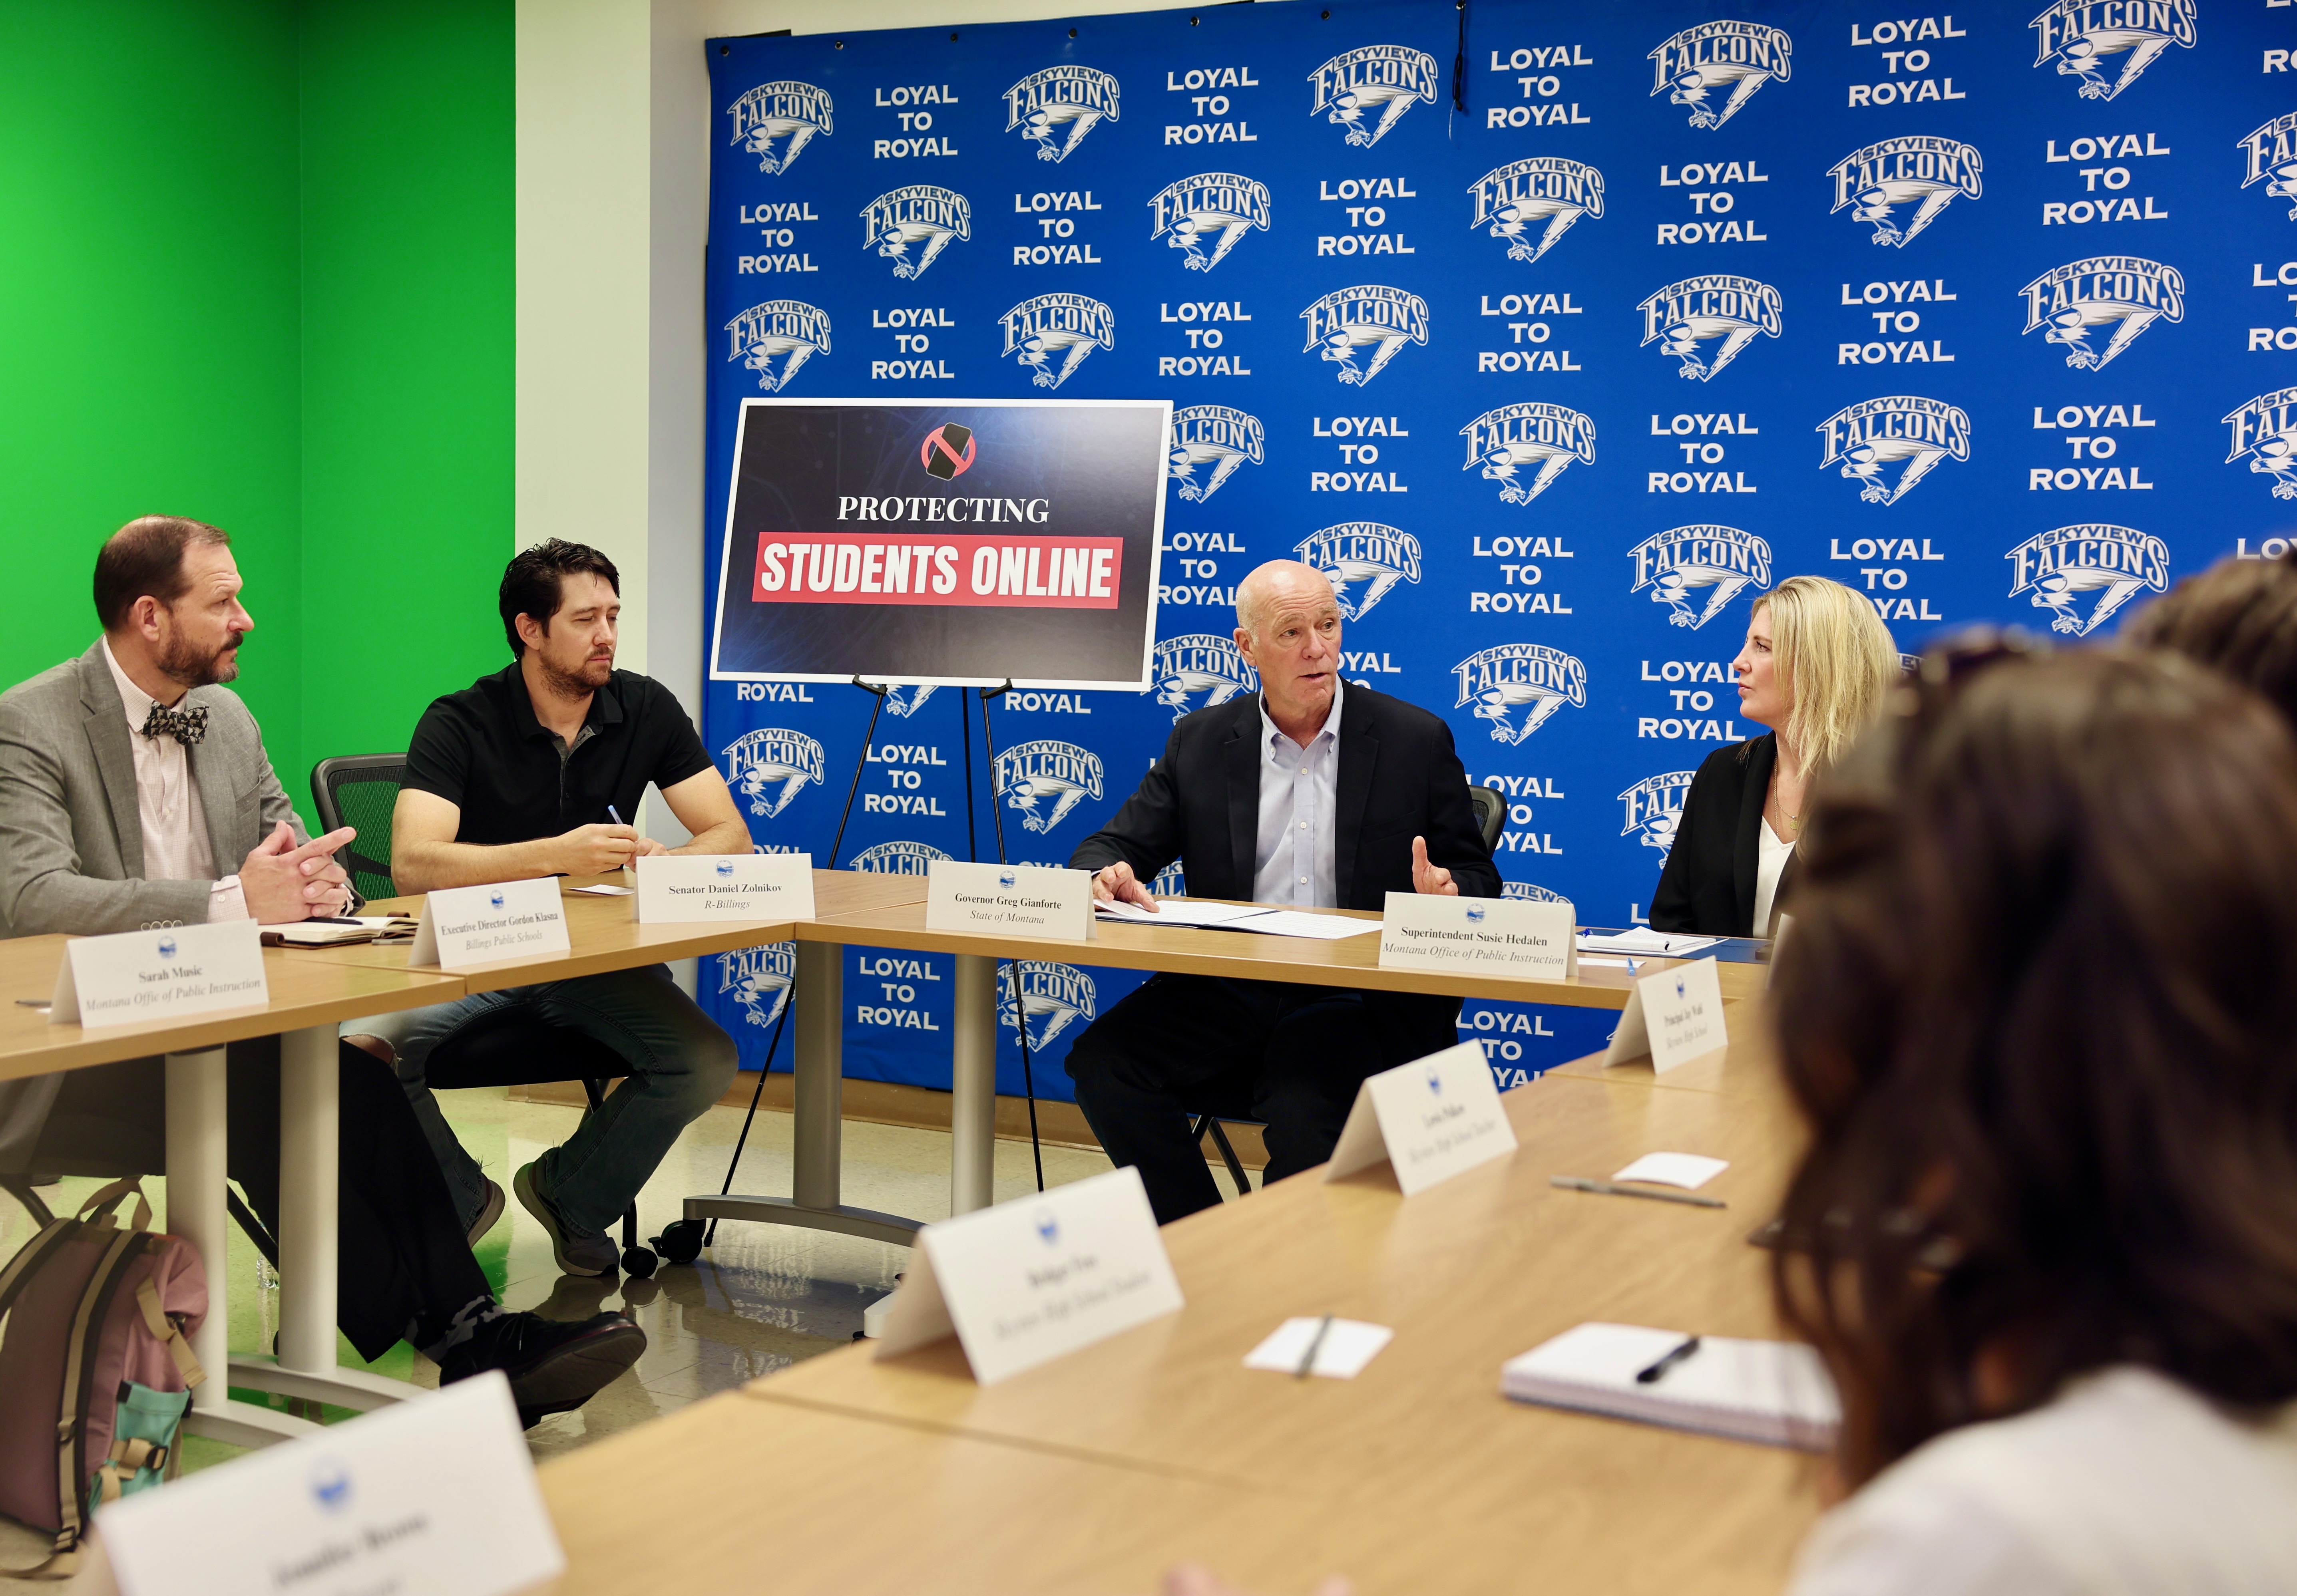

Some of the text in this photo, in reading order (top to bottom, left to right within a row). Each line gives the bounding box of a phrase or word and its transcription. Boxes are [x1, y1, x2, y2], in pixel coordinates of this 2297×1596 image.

[1681, 22, 1770, 43] SKYVIEW
[1852, 16, 1966, 46] LOYAL
[2028, 0, 2197, 68] FALCONS
[1338, 47, 1418, 66] SKYVIEW
[1491, 45, 1592, 71] LOYAL
[1647, 29, 1791, 96] FALCONS
[1882, 50, 1930, 73] TO
[1029, 68, 1102, 85] SKYVIEW
[1168, 67, 1258, 90] LOYAL
[1307, 53, 1437, 116] FALCONS
[1518, 76, 1560, 97] TO
[750, 83, 816, 100] SKYVIEW
[876, 85, 958, 106] LOYAL
[1849, 78, 1965, 107] ROYAL
[1002, 74, 1120, 132] FALCONS
[1192, 96, 1229, 116] TO
[727, 89, 833, 145] FALCONS
[898, 112, 932, 131] TO
[1487, 103, 1590, 128] ROYAL
[1165, 122, 1257, 145] ROYAL
[875, 137, 957, 158] ROYAL
[1862, 138, 1959, 160] SKYVIEW
[2047, 133, 2170, 162] LOYAL
[1499, 159, 1584, 179] SKYVIEW
[1660, 161, 1768, 186] LOYAL
[1826, 144, 1982, 214] FALCONS
[2080, 167, 2130, 191] TO
[1176, 175, 1252, 193] SKYVIEW
[1320, 178, 1416, 200] LOYAL
[885, 187, 953, 204] SKYVIEW
[1015, 191, 1101, 212] LOYAL
[1467, 166, 1604, 229] FALCONS
[1690, 192, 1734, 214] TO
[741, 203, 818, 223] LOYAL
[1147, 181, 1270, 240] FALCONS
[1346, 207, 1385, 227] TO
[2043, 197, 2168, 225] ROYAL
[860, 194, 971, 249] FALCONS
[1039, 219, 1074, 237] TO
[762, 229, 793, 247] TO
[1658, 221, 1767, 244] ROYAL
[1014, 244, 1101, 265] ROYAL
[1318, 234, 1415, 256] ROYAL
[739, 254, 818, 274] ROYAL
[2057, 258, 2160, 280] SKYVIEW
[1329, 287, 1409, 304] SKYVIEW
[1670, 277, 1760, 296] SKYVIEW
[1842, 280, 1957, 304] LOYAL
[749, 302, 814, 318] SKYVIEW
[1025, 295, 1096, 312] SKYVIEW
[1481, 294, 1582, 315] LOYAL
[2018, 266, 2184, 335] FALCONS
[873, 308, 954, 327] LOYAL
[1161, 302, 1251, 322] LOYAL
[1636, 284, 1782, 347] FALCONS
[1873, 311, 1919, 333] TO
[998, 302, 1114, 357] FALCONS
[1300, 294, 1429, 353] FALCONS
[1509, 323, 1550, 343] TO
[725, 308, 831, 362] FALCONS
[896, 334, 929, 353] TO
[1186, 329, 1222, 348] TO
[1479, 351, 1581, 372] ROYAL
[1838, 340, 1955, 364] ROYAL
[872, 360, 954, 379] ROYAL
[1159, 356, 1250, 376] ROYAL
[1491, 405, 1575, 422] SKYVIEW
[1851, 398, 1947, 417] SKYVIEW
[2034, 405, 2156, 428] LOYAL
[1314, 417, 1408, 437] LOYAL
[1651, 413, 1758, 435] LOYAL
[1170, 415, 1264, 465] ALCONS
[1459, 411, 1595, 471] FALCONS
[1815, 406, 1970, 469] FALCONS
[2066, 436, 2116, 459] TO
[1339, 445, 1378, 464] TO
[1680, 443, 1724, 463] TO
[1311, 472, 1407, 492] ROYAL
[1648, 472, 1756, 493] ROYAL
[2029, 467, 2153, 490] ROYAL
[837, 497, 1049, 523] PROTECTING
[1323, 524, 1402, 541] SKYVIEW
[1661, 527, 1750, 545] SKYVIEW
[2043, 527, 2144, 545] SKYVIEW
[1473, 537, 1573, 557] LOYAL
[1830, 539, 1944, 560] LOYAL
[761, 543, 1114, 598] STUDENTS ONLINE
[1180, 559, 1217, 578] TO
[1627, 533, 1771, 593] FALCONS
[2004, 533, 2169, 597] FALCONS
[1500, 564, 1541, 585] TO
[1861, 568, 1907, 590] TO
[1471, 592, 1572, 614] ROYAL
[1165, 636, 1238, 652] SKYVIEW
[1483, 646, 1566, 664] SKYVIEW
[1451, 651, 1586, 708] FALCONS
[738, 683, 813, 702] ROYAL
[1005, 692, 1091, 714] ROYAL
[1670, 690, 1713, 711] TO
[745, 730, 808, 746] SKYVIEW
[1638, 718, 1746, 741] ROYAL
[723, 734, 824, 785] FALCONS
[866, 742, 946, 766] LOYAL
[1015, 742, 1086, 760] SKYVIEW
[888, 770, 921, 789] TO
[993, 746, 1103, 801] FALCONS
[865, 794, 945, 816] ROYAL
[874, 843, 940, 861] SKYVIEW
[669, 883, 782, 895] Senator Daniel Zolnikov
[705, 899, 750, 910] R-Billings
[955, 893, 1062, 910] Governor Greg Gianforte
[441, 922, 477, 936] Executive
[478, 918, 507, 931] Director
[509, 914, 534, 926] Gordon
[970, 910, 1045, 924] State of Montana
[466, 930, 543, 950] Billings Public Schools
[1401, 926, 1547, 946] Superintendent Susie Hedalen
[1383, 943, 1564, 965] Montana Office of Public Instruction
[139, 965, 203, 983] Sarah Music
[860, 957, 940, 980] LOYAL
[86, 998, 130, 1012] Montana
[163, 988, 172, 1003] of
[176, 985, 205, 999] Public
[209, 979, 261, 994] Instruction
[882, 984, 914, 1002] TO
[858, 1006, 938, 1030] ROYAL
[1481, 1038, 1522, 1060] TO
